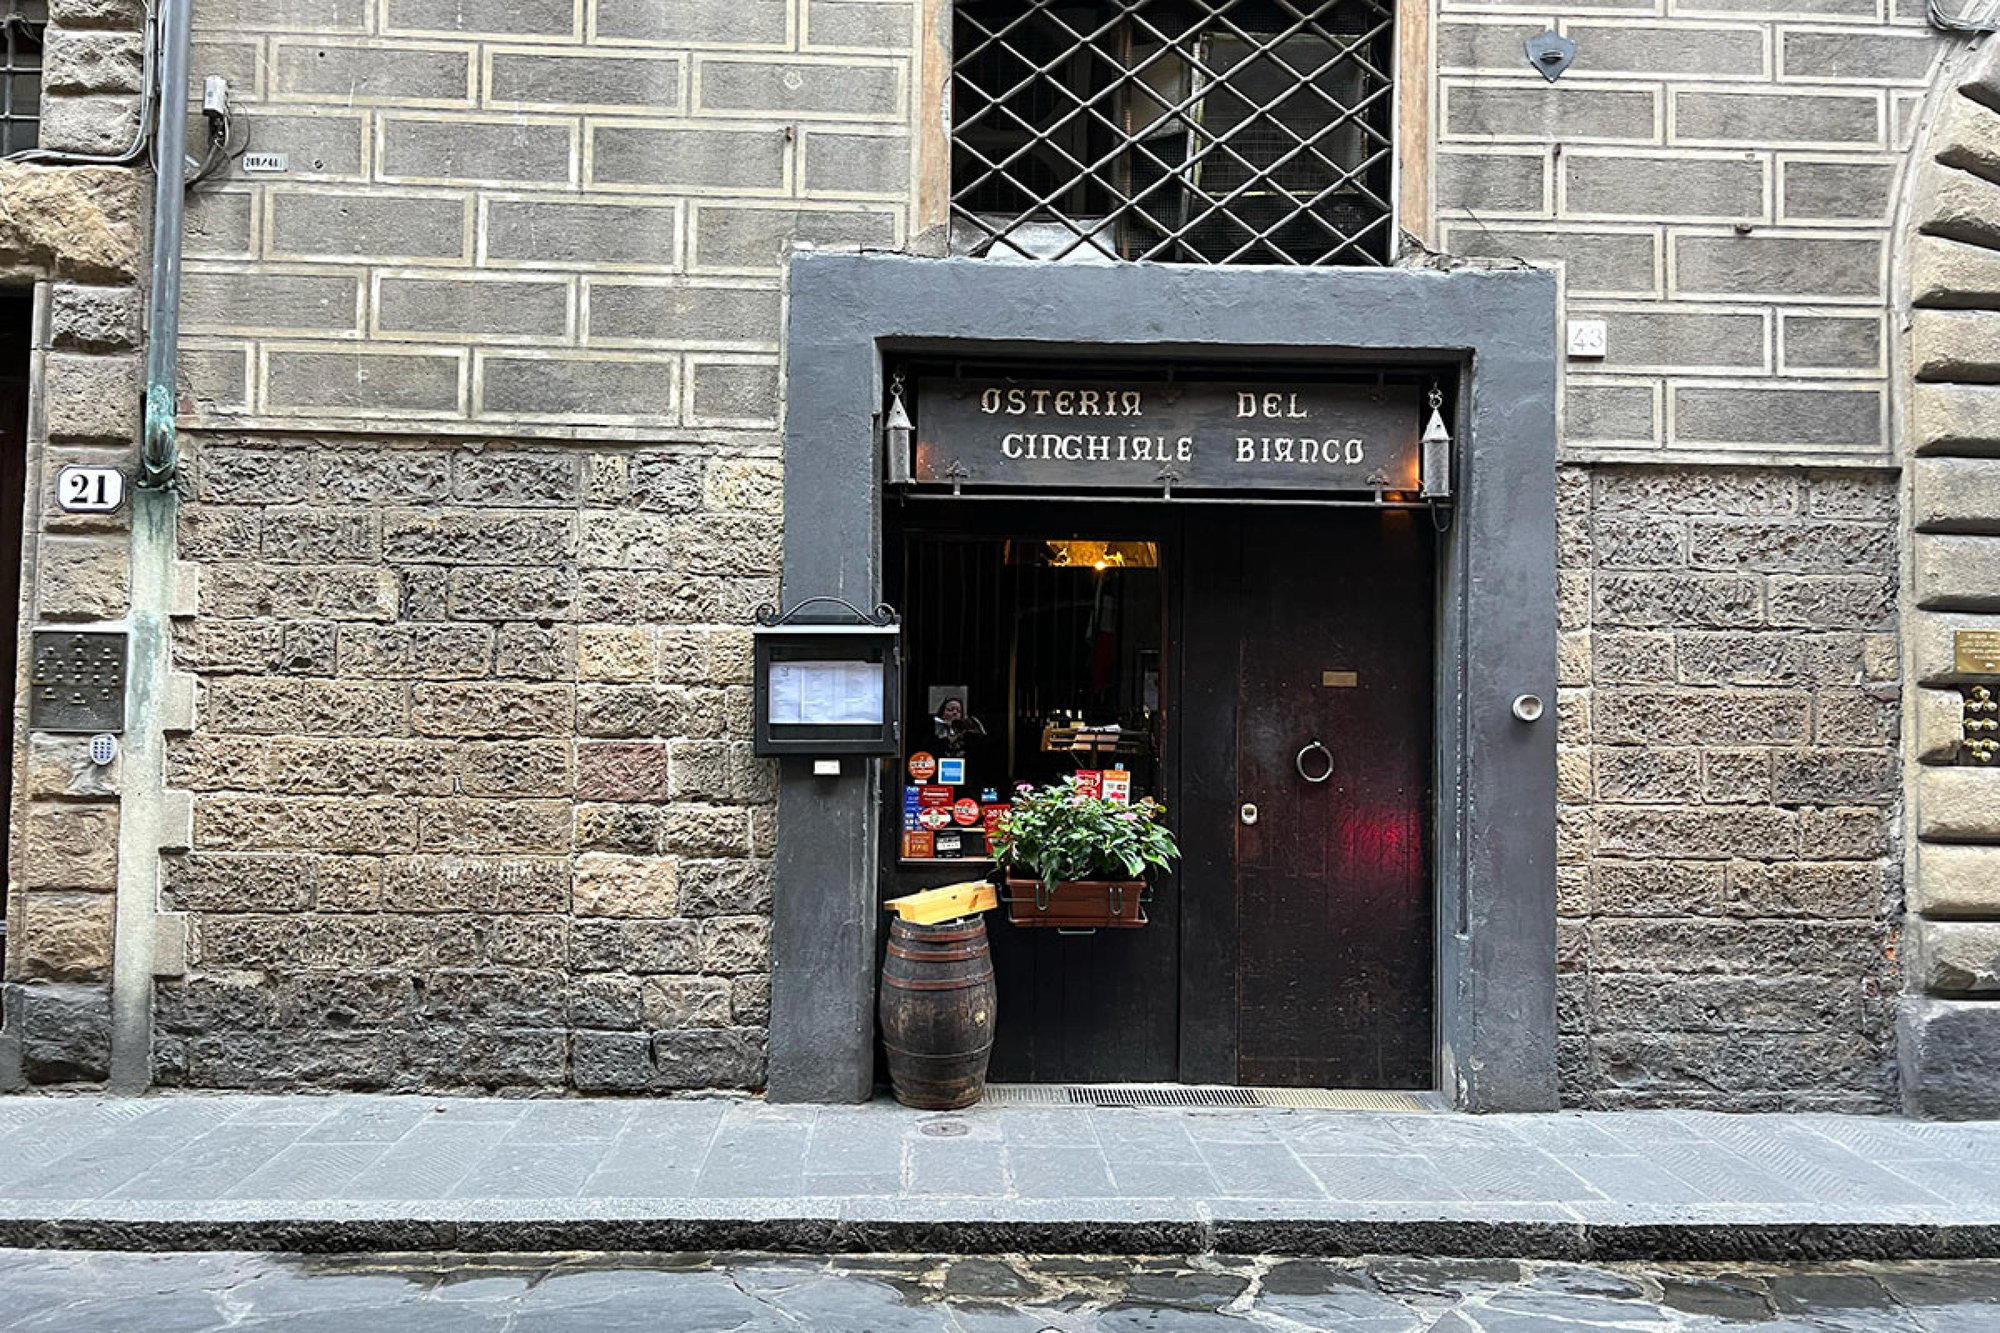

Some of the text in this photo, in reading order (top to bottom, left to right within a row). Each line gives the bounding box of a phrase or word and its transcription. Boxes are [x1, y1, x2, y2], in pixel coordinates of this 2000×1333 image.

[1572, 327, 1604, 350] 43
[981, 388, 1308, 418] OSTERIA DEL
[1001, 433, 1365, 465] CINGHIALE BIANCO
[70, 474, 108, 504] 21
